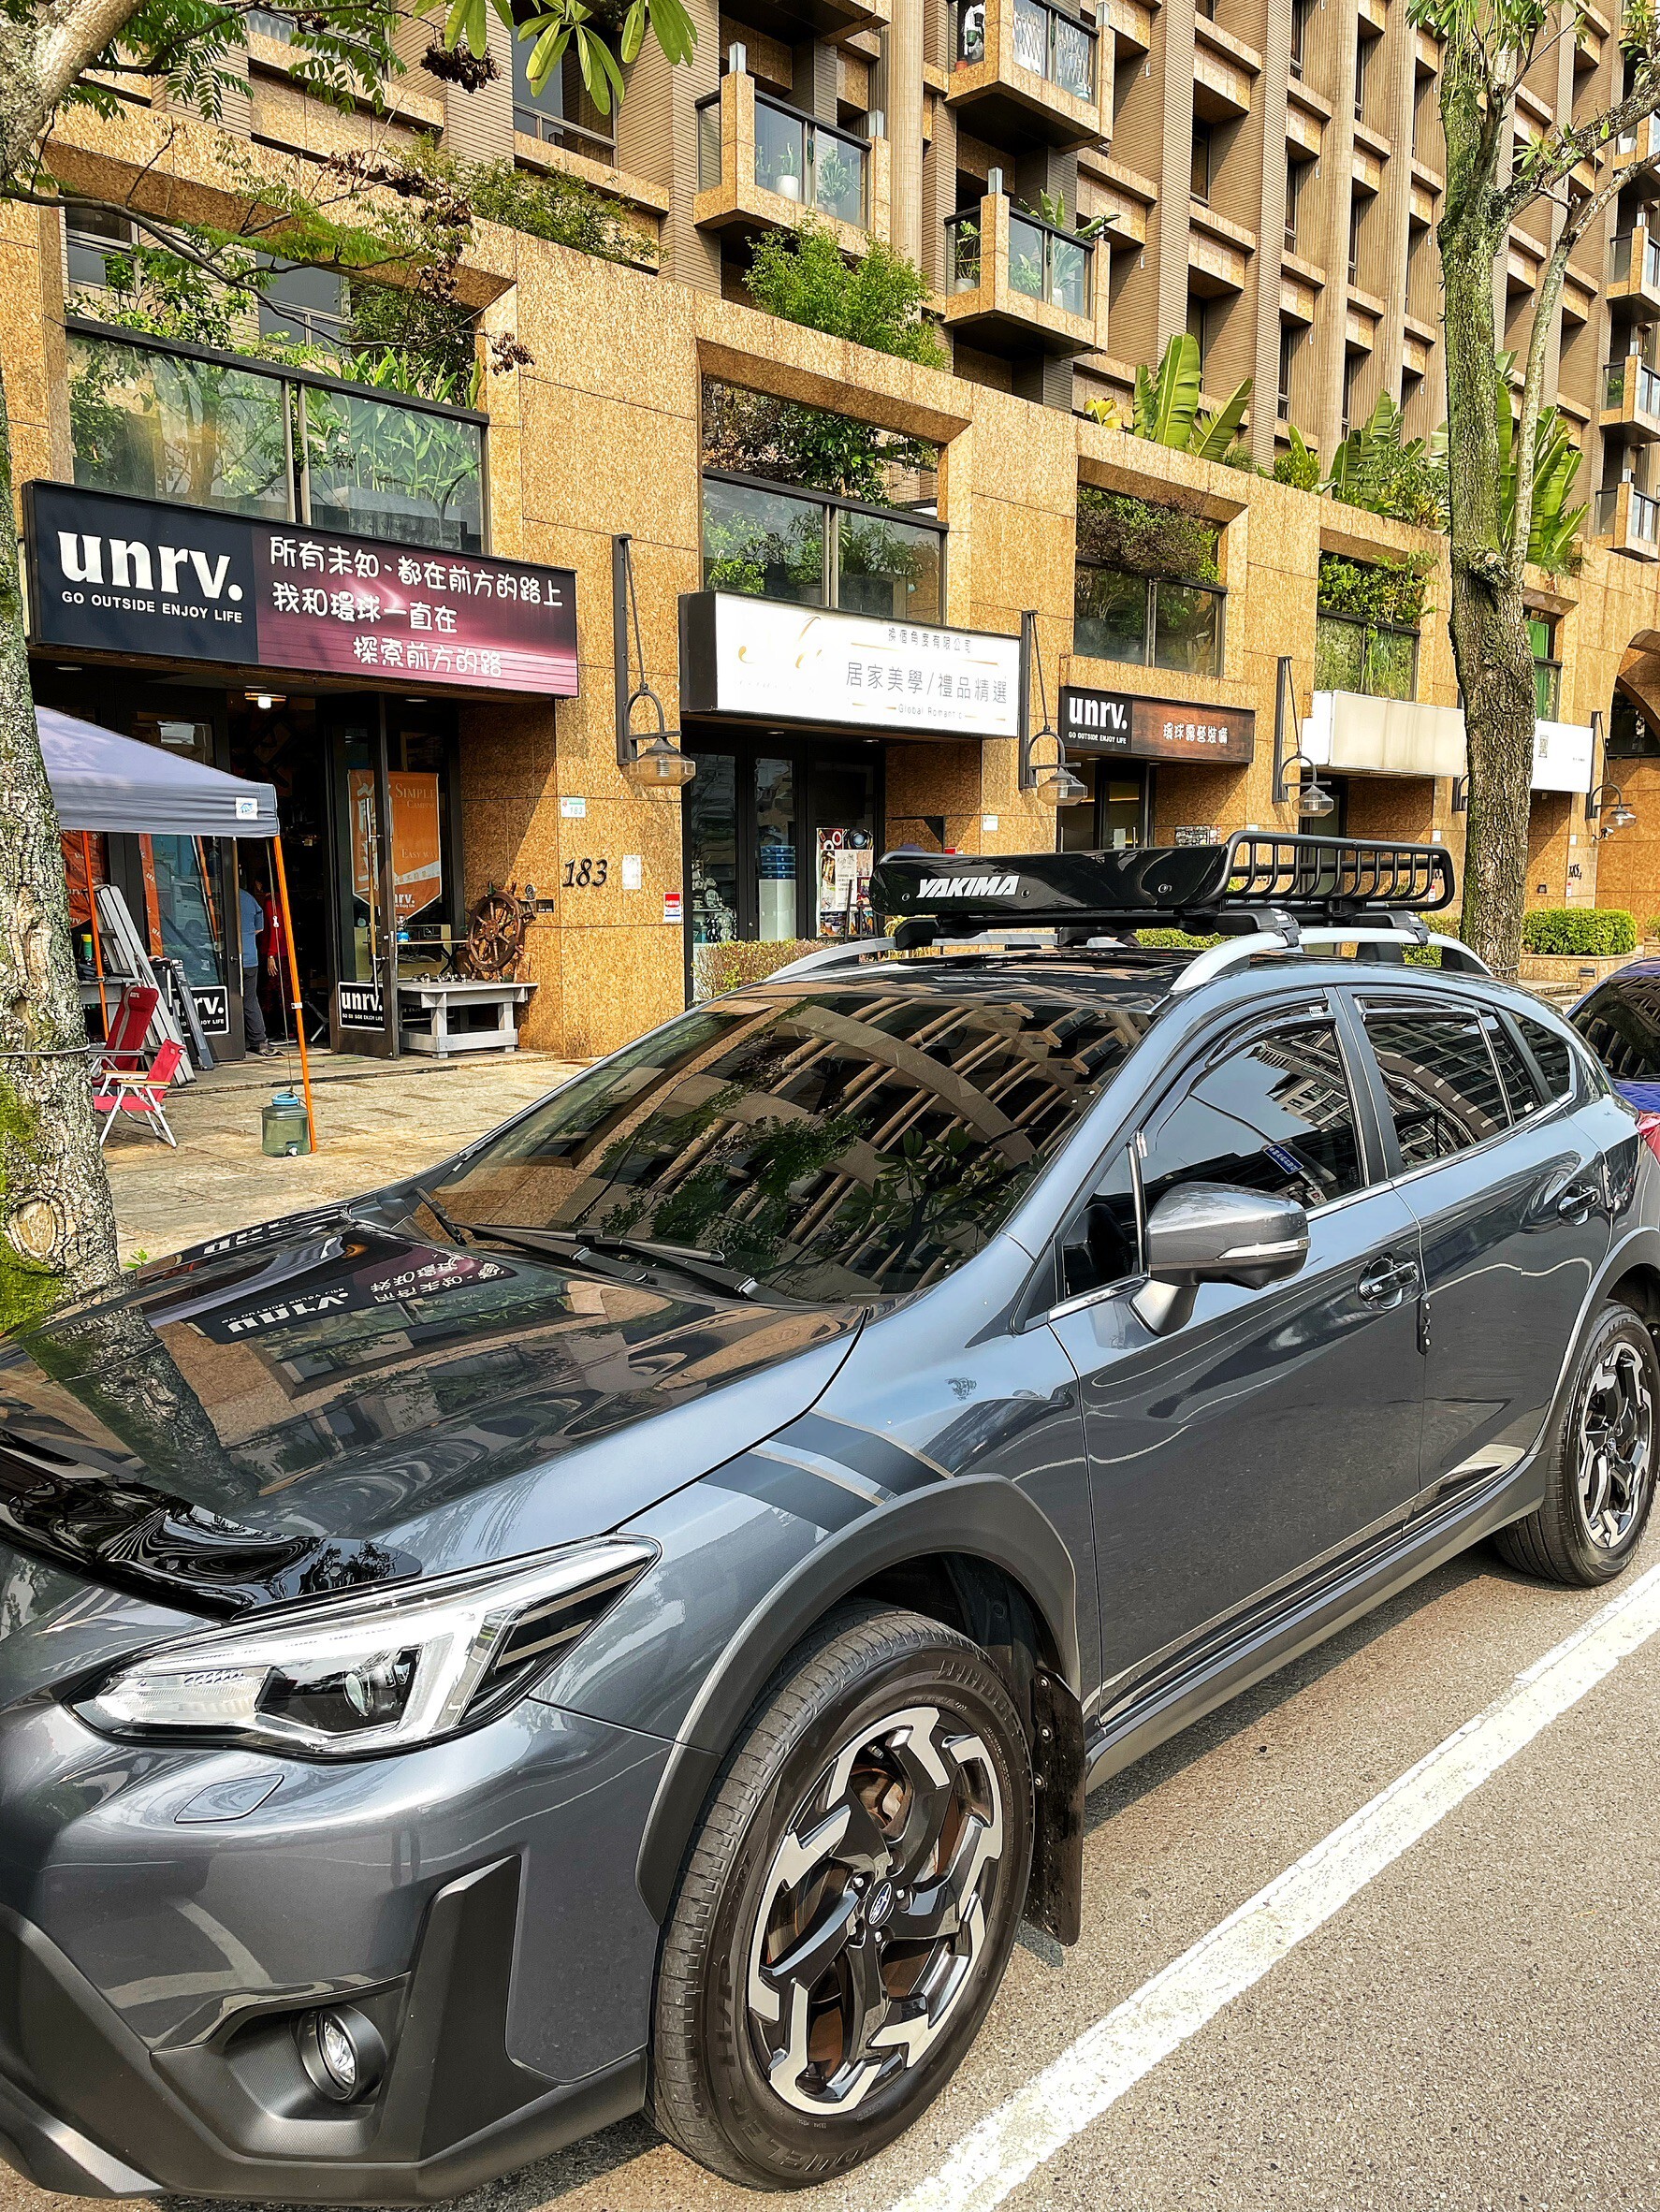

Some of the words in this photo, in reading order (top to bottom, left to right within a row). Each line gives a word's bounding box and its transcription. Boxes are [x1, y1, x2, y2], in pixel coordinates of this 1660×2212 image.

[57, 531, 244, 602] unrv.
[269, 536, 563, 607] 所有未知、都在前方的路上
[62, 590, 85, 605] GO
[91, 594, 155, 613] OUTSIDE
[162, 602, 209, 618] ENJOY
[214, 609, 243, 624] LIFE
[272, 581, 459, 633] 我和環球一直在
[353, 636, 502, 677] 探索前方的路
[927, 706, 963, 720] Romantc
[1069, 696, 1128, 730] unrv.
[1069, 731, 1077, 739] GO
[1077, 733, 1099, 742] OUTSIDE
[1099, 734, 1115, 744] ENJOY
[1116, 735, 1127, 745] LIFE
[395, 783, 436, 799] SIMPLE
[570, 807, 583, 815] 183
[401, 848, 420, 859] EASY
[562, 858, 607, 887] 183
[916, 875, 1020, 898] YAKIMA
[395, 894, 415, 904] rv.
[341, 992, 383, 1011] unrv.
